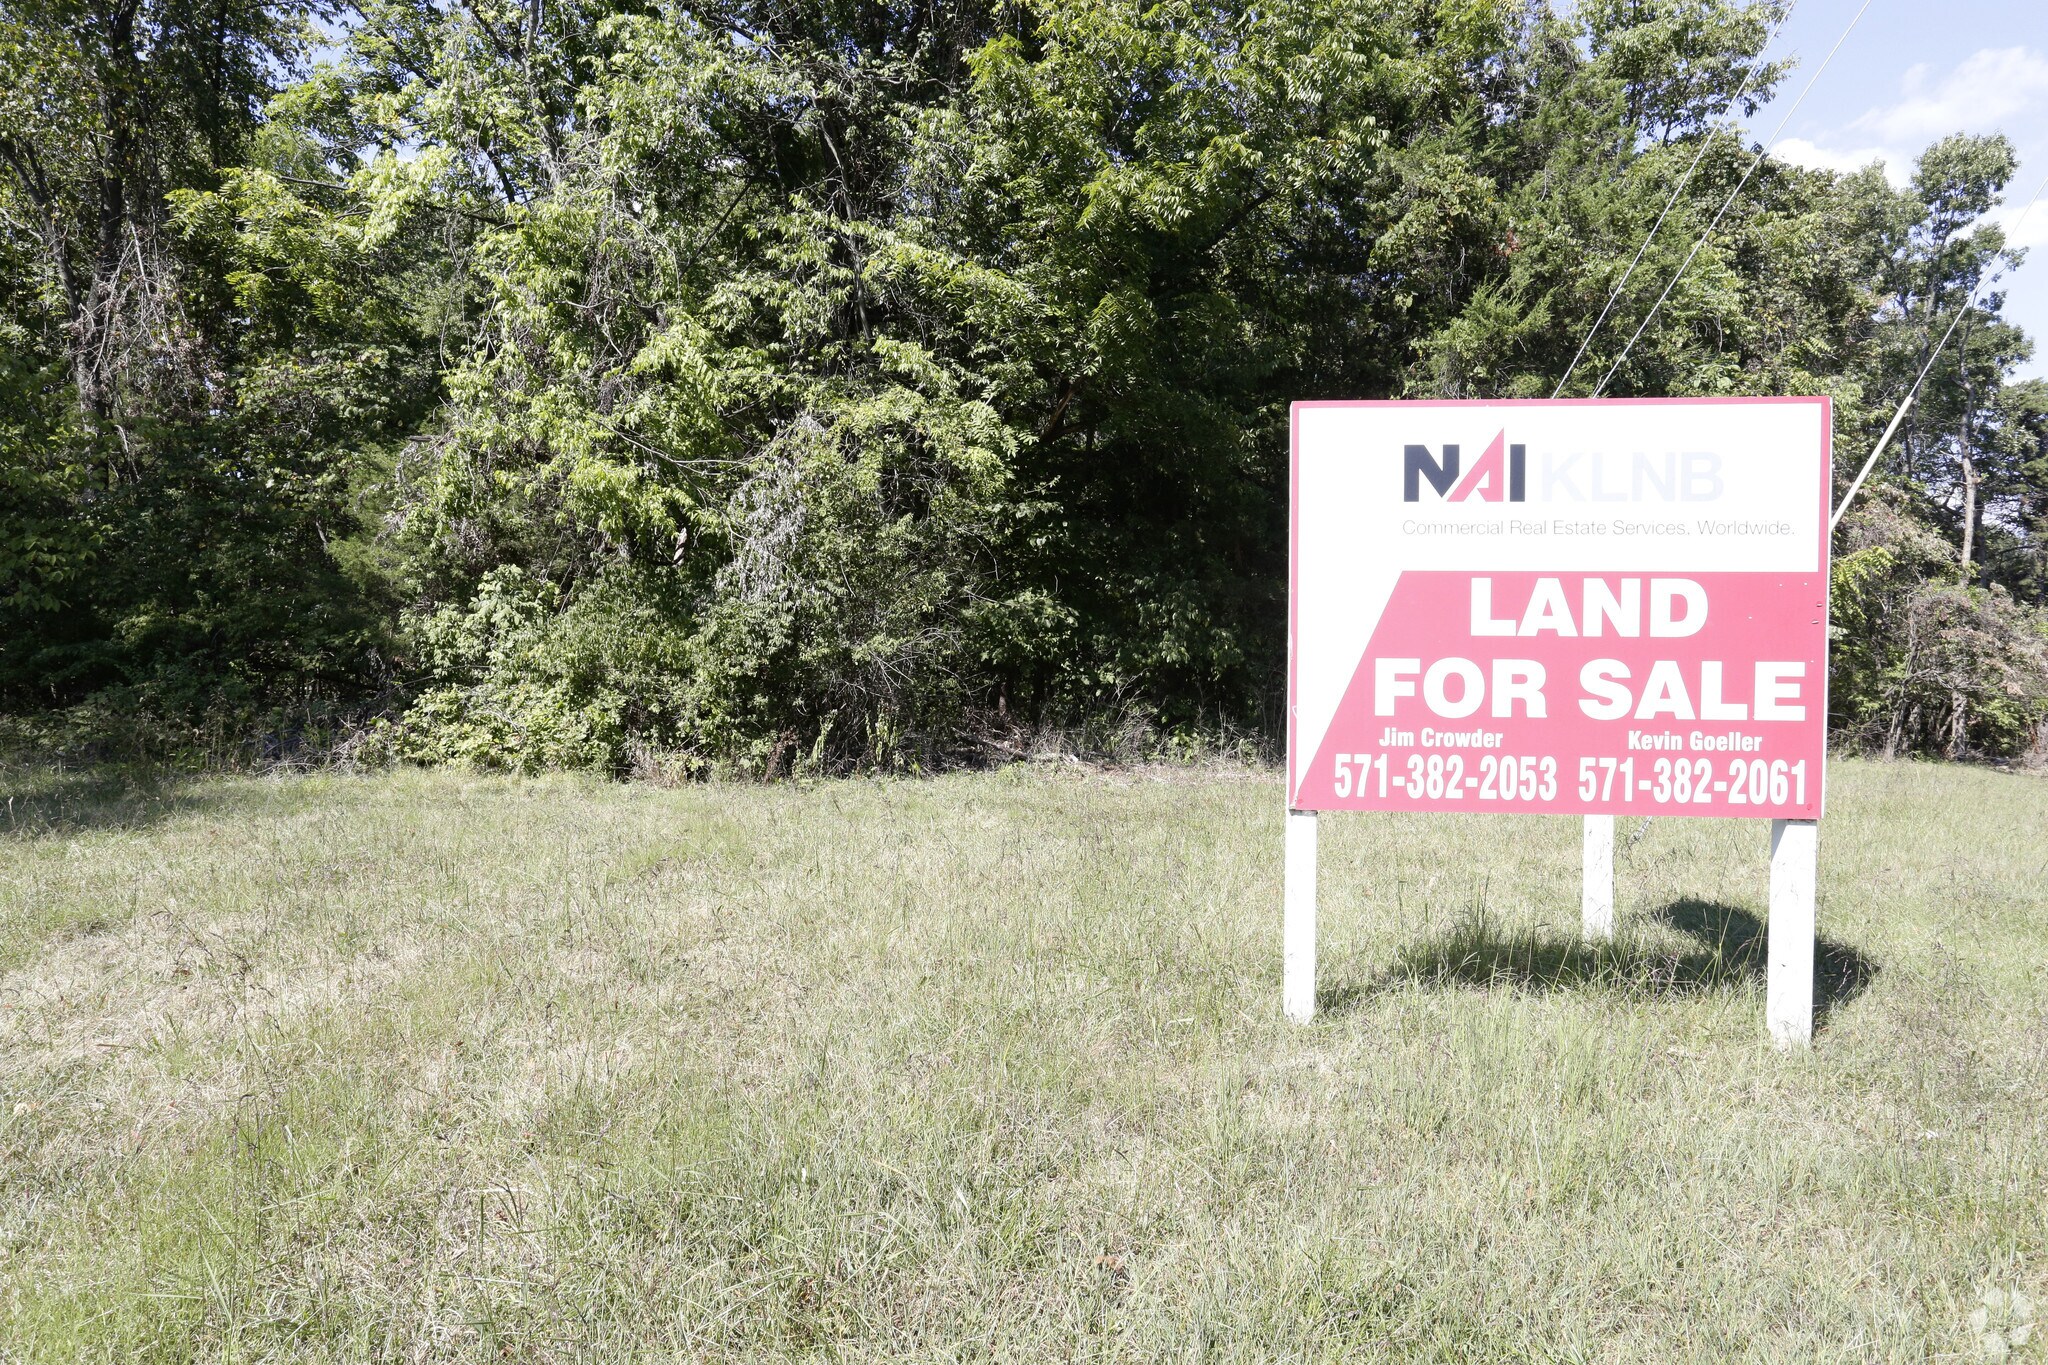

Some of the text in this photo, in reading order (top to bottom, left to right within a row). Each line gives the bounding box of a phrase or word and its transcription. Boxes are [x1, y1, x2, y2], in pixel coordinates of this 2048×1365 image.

[1403, 427, 1725, 502] NAI KLNB
[1402, 519, 1796, 537] Commercial Real Estate Services. Worldwide.
[1469, 577, 1709, 638] LAND
[1374, 656, 1806, 722] FOR SALE
[1378, 727, 1504, 749] Jim Crowder
[1627, 730, 1763, 752] Kevin Goeller
[1333, 753, 1558, 802] 571-382-2053
[1577, 756, 1806, 805] 571-382-2061
